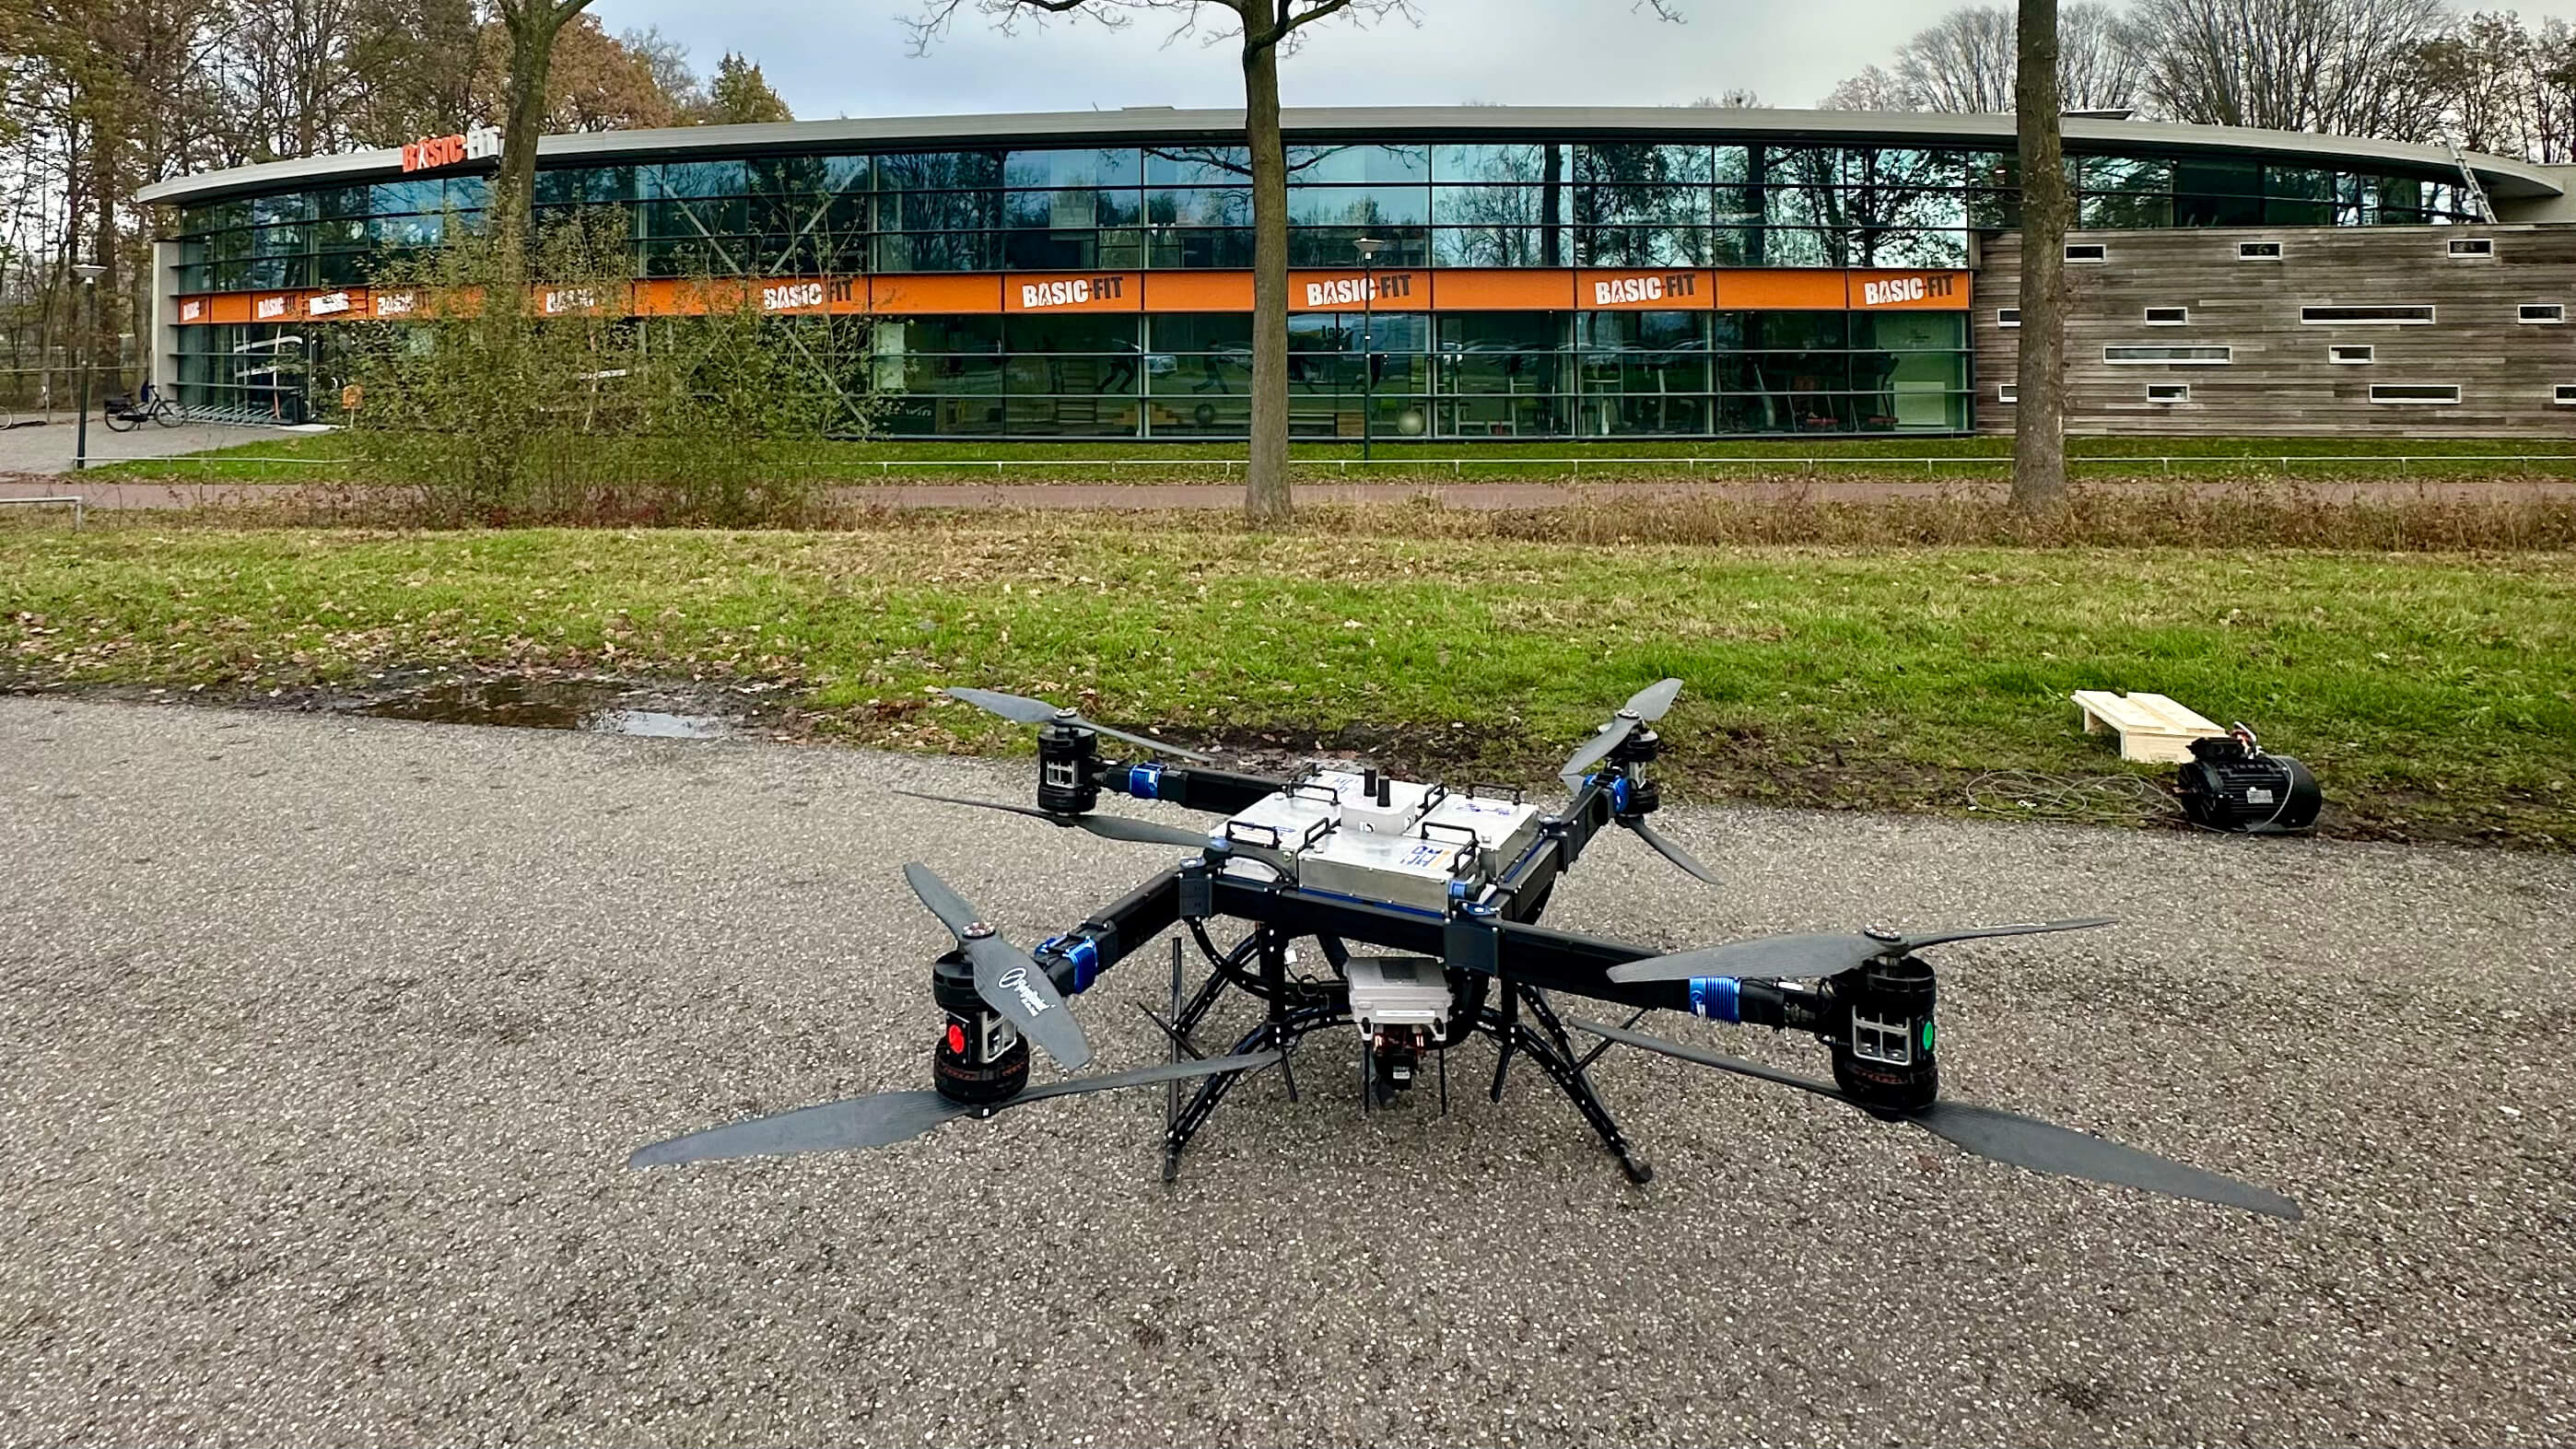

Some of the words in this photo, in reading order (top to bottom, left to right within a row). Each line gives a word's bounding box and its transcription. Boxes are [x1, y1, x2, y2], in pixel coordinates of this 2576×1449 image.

[1022, 276, 1123, 308] BASIC-FIT
[1306, 275, 1411, 306] BASIC-FIT
[1595, 274, 1695, 305] BASIC-FIT
[1865, 275, 1953, 305] BASIC-FIT
